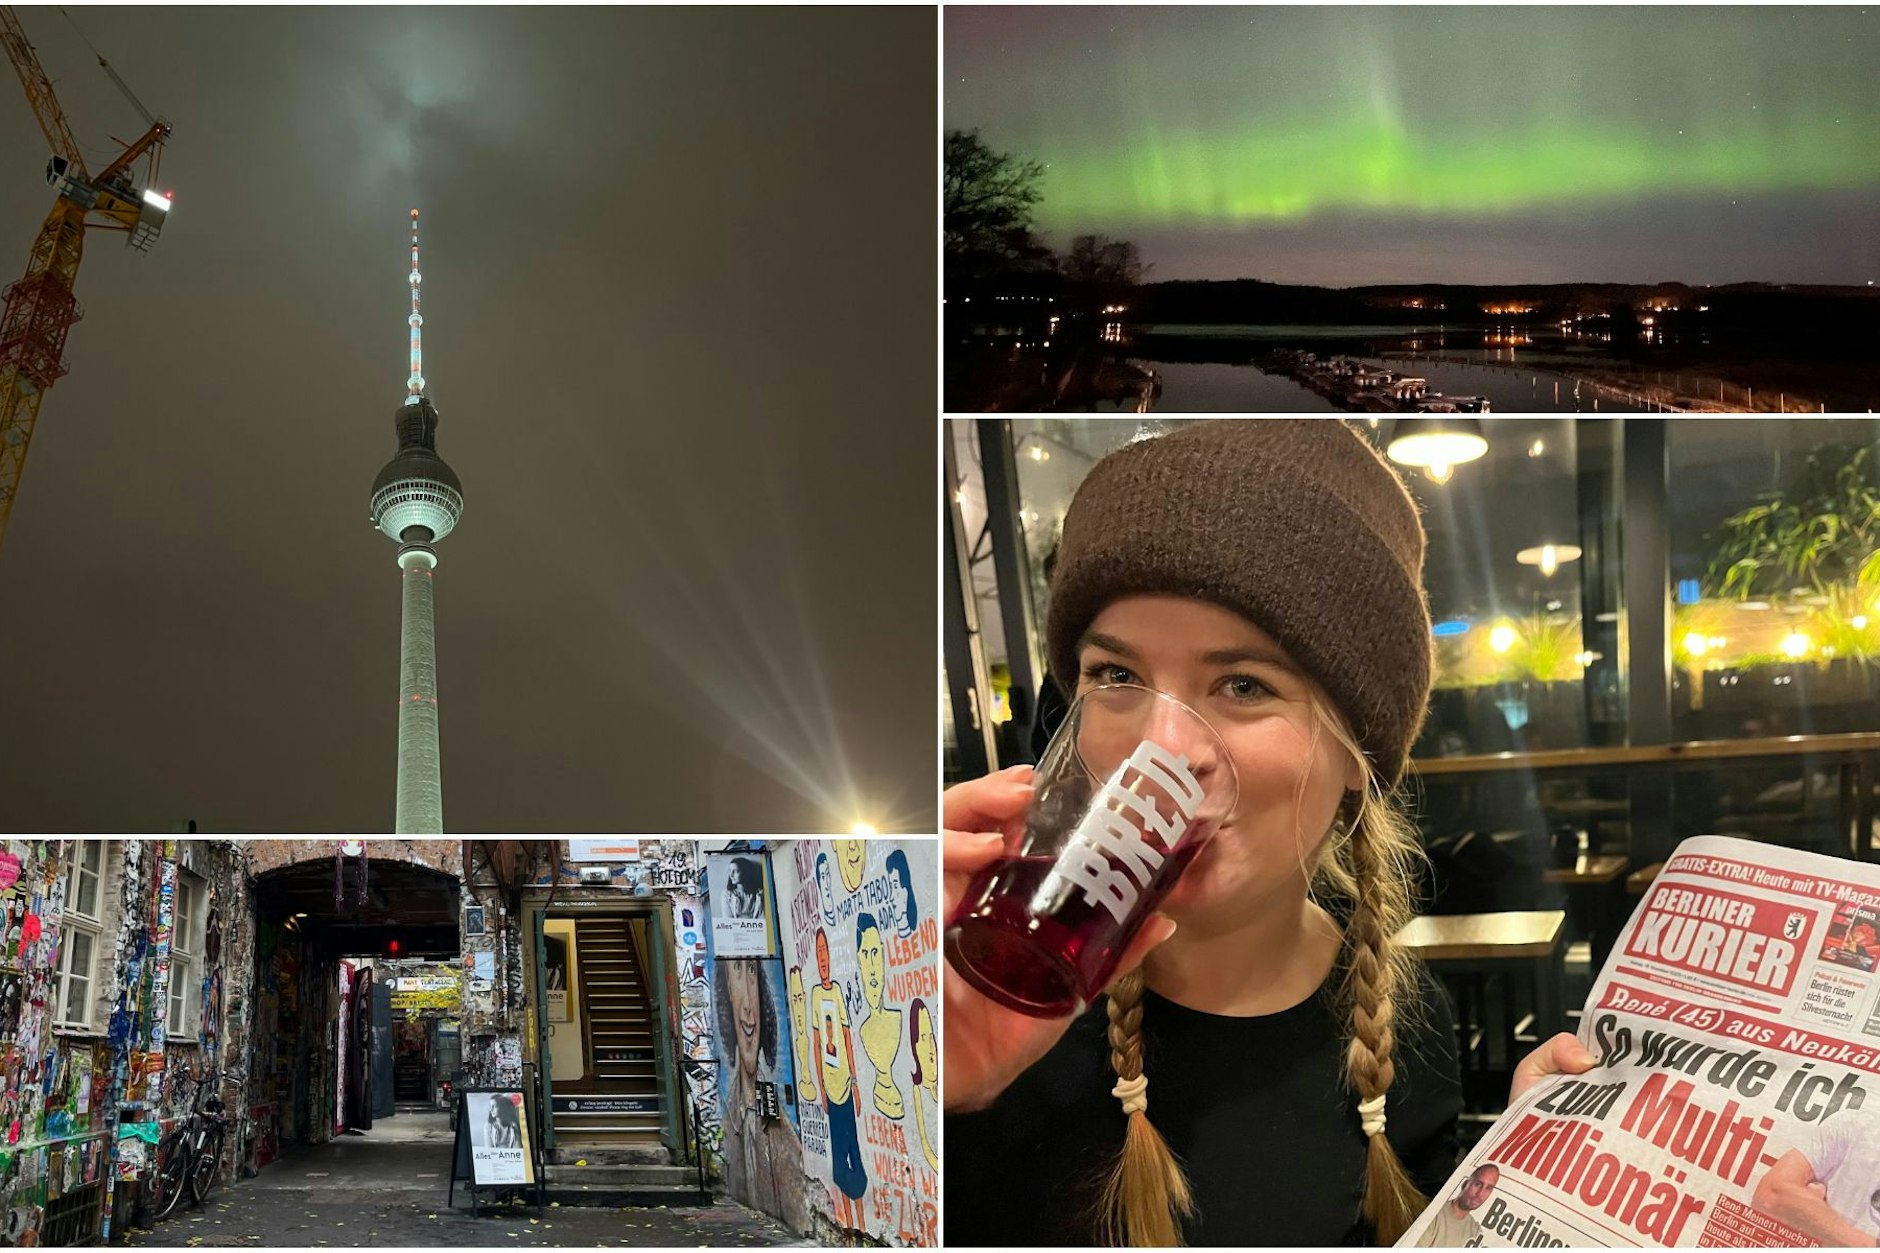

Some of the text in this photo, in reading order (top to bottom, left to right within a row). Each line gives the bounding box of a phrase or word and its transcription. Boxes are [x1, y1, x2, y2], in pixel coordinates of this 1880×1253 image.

[837, 891, 864, 923] MARTA
[1750, 869, 1789, 889] Heute
[1791, 879, 1815, 893] mit
[1815, 880, 1880, 908] TV-Magaz
[740, 921, 764, 929] Anne
[1651, 888, 1756, 928] BERLINER
[886, 917, 938, 966] LEBEND
[1632, 913, 1796, 990] KURIER
[887, 964, 938, 1002] WURDEN
[1806, 991, 1846, 1008] sich für die
[1811, 979, 1855, 998] Berlin rüstet
[1608, 987, 1880, 1071] René (45) aus Neuköl
[1801, 1002, 1853, 1022] Silvesternacht
[1593, 1014, 1866, 1126] So wurde ich
[1534, 1071, 1780, 1188] zum Multi-
[475, 1152, 492, 1160] Alles
[498, 1151, 521, 1159] Anne
[1488, 1113, 1706, 1248] Millionär
[1706, 1222, 1731, 1240] heute
[1712, 1207, 1739, 1229] Berlin
[1740, 1224, 1756, 1237] auf
[1718, 1195, 1741, 1212] René
[1742, 1207, 1777, 1230] Meinert
[1778, 1225, 1808, 1247] wuchs
[1700, 1235, 1710, 1247] in
